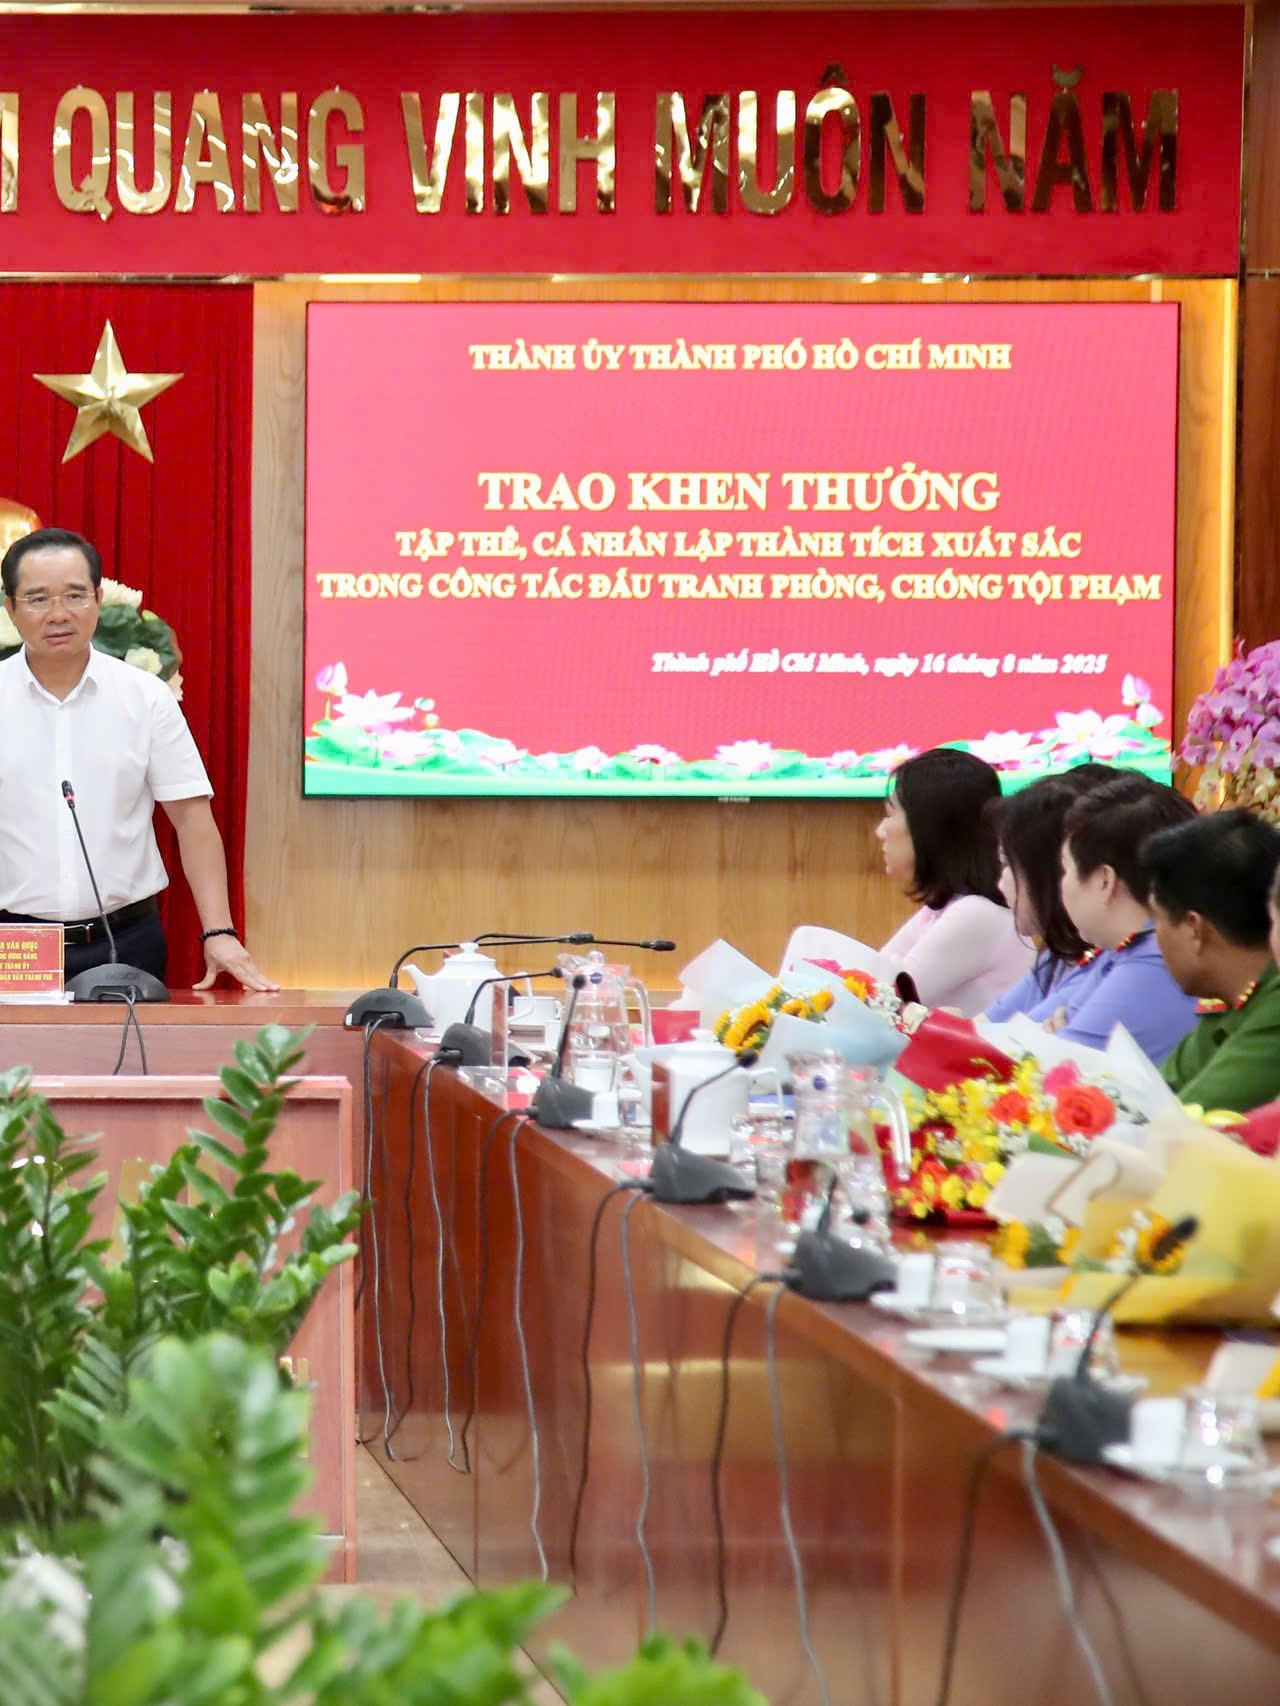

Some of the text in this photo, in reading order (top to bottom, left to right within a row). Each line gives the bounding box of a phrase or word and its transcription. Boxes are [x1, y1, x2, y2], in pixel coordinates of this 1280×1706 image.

[52, 86, 366, 222] QUANG
[400, 90, 617, 215] VINH
[654, 63, 927, 216] MUÔN
[968, 63, 1181, 215] NĂM
[469, 338, 576, 370] THÀNH
[629, 338, 737, 370] THÀNH
[865, 337, 922, 370] CHÍ
[928, 343, 1012, 370] MINH
[478, 461, 1000, 511] TRAO KHEN THƯỞNG
[396, 527, 455, 562] TẬP
[532, 525, 577, 557] CÁ
[581, 525, 668, 557] NHÂN
[673, 527, 733, 562] LẬP
[736, 525, 844, 557] THÀNH
[850, 525, 925, 557] TÍCH
[316, 573, 423, 599] TRONG
[428, 566, 517, 599] CÔNG
[521, 566, 584, 599] TÁC
[658, 573, 765, 599] TRANH
[770, 567, 886, 604] PHÒNG,
[1007, 570, 1063, 605] TỘI
[1070, 574, 1162, 605] PHẠM
[921, 653, 946, 673] 16
[1060, 653, 1108, 674] 2025
